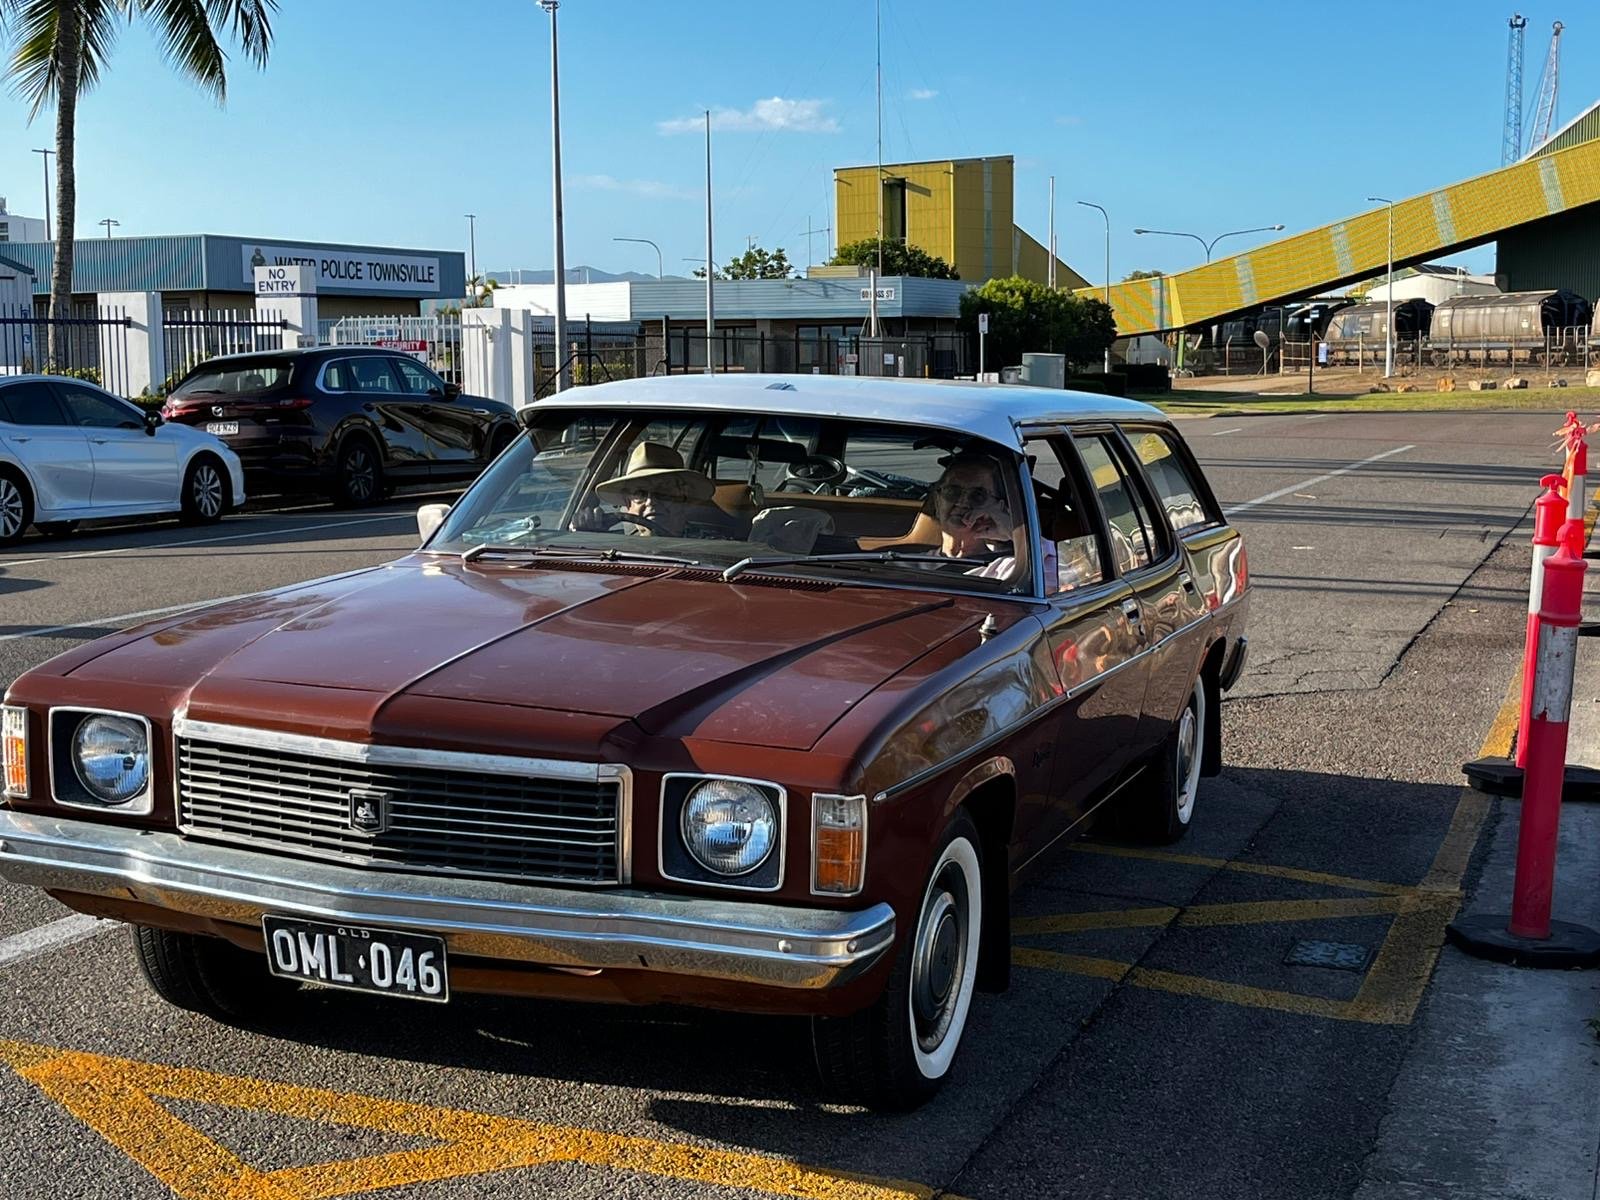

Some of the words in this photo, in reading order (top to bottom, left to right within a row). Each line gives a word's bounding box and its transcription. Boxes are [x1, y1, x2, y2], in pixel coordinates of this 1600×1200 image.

[268, 268, 286, 280] NO
[321, 259, 363, 280] POLICE
[367, 262, 435, 283] TOWNSVILLE
[258, 280, 297, 292] ENTRY
[381, 341, 421, 350] SECURITY
[337, 927, 371, 939] QLD
[273, 929, 354, 983] OML
[369, 942, 441, 994] 046
